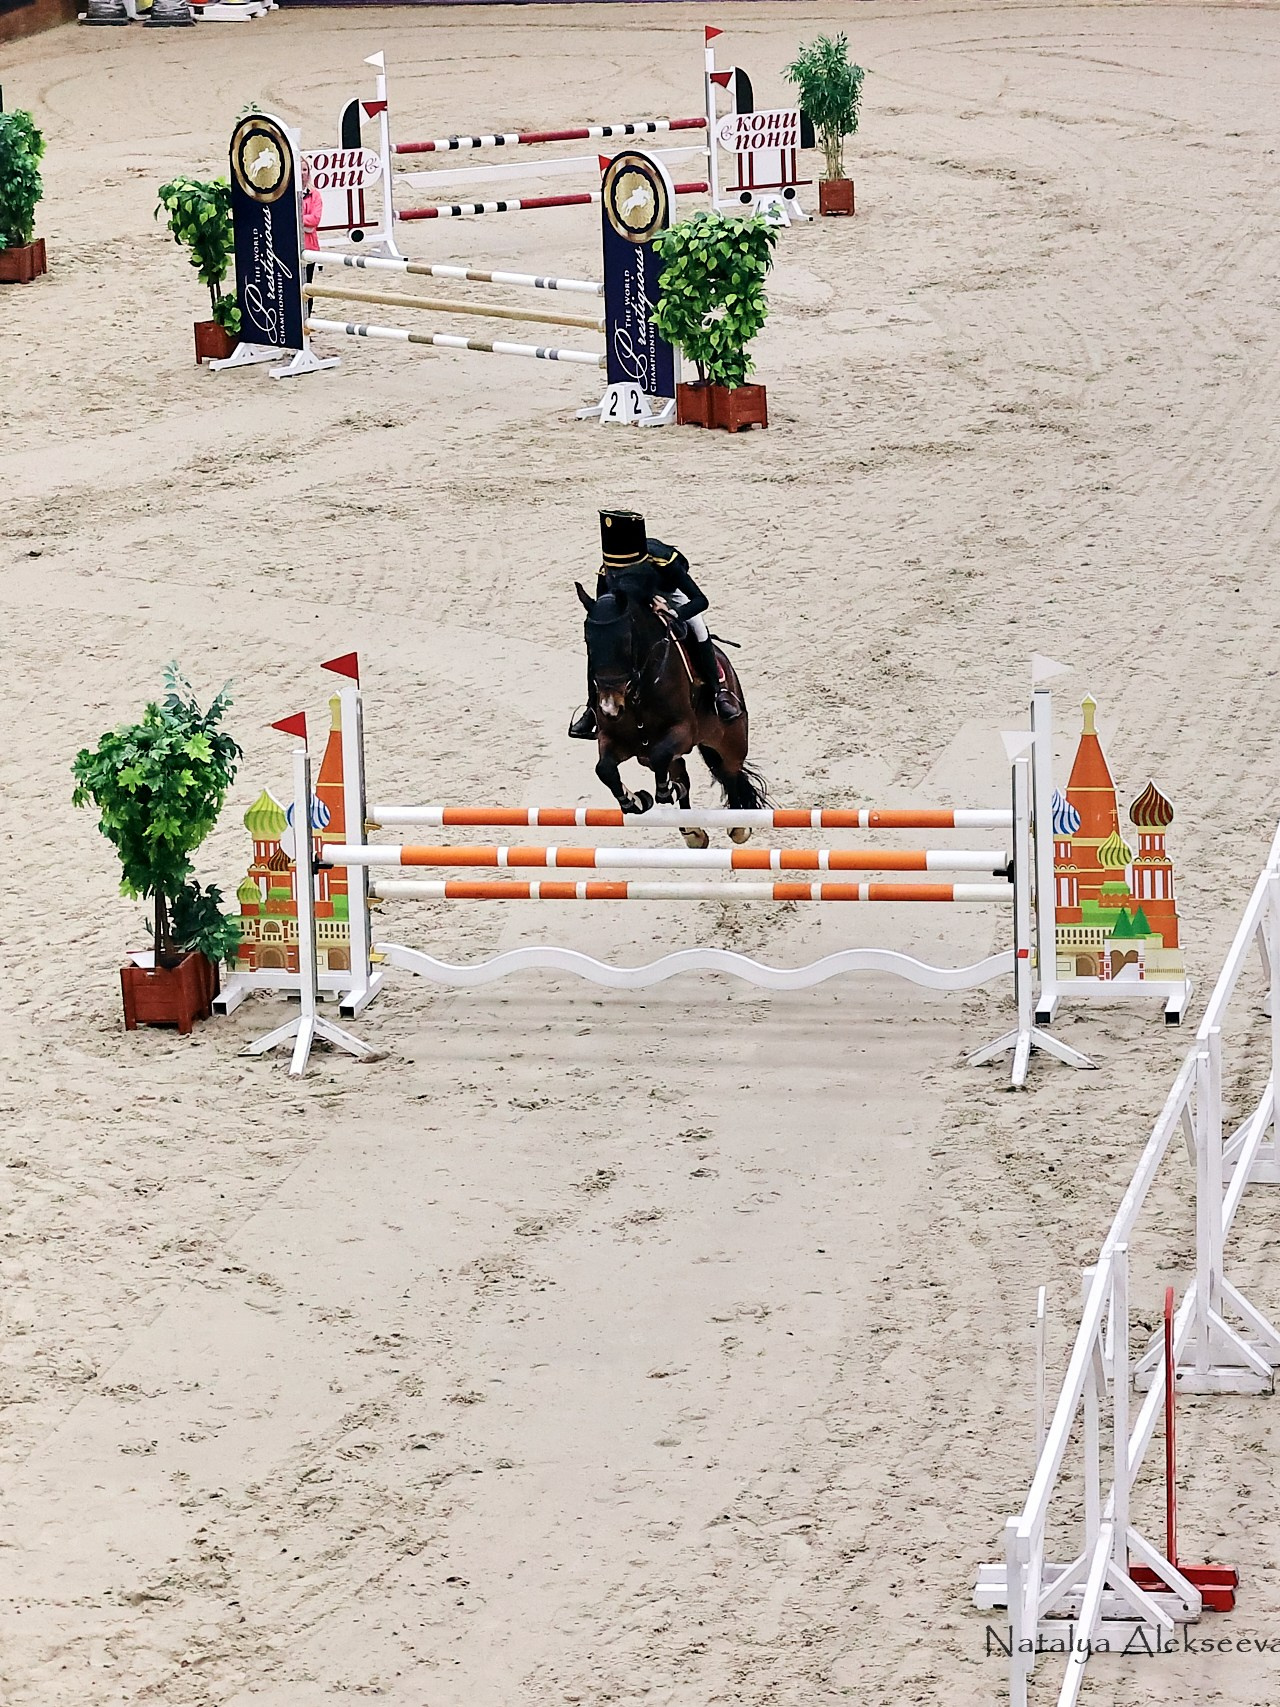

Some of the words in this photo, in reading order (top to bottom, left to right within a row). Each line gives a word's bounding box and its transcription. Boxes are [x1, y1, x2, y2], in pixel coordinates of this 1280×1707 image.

[312, 170, 364, 190] они
[252, 227, 260, 262] WORLD
[244, 205, 293, 344] Prestigious
[277, 271, 286, 345] CHAMPIONSHIP
[609, 391, 619, 417] 2
[630, 389, 642, 416] 2
